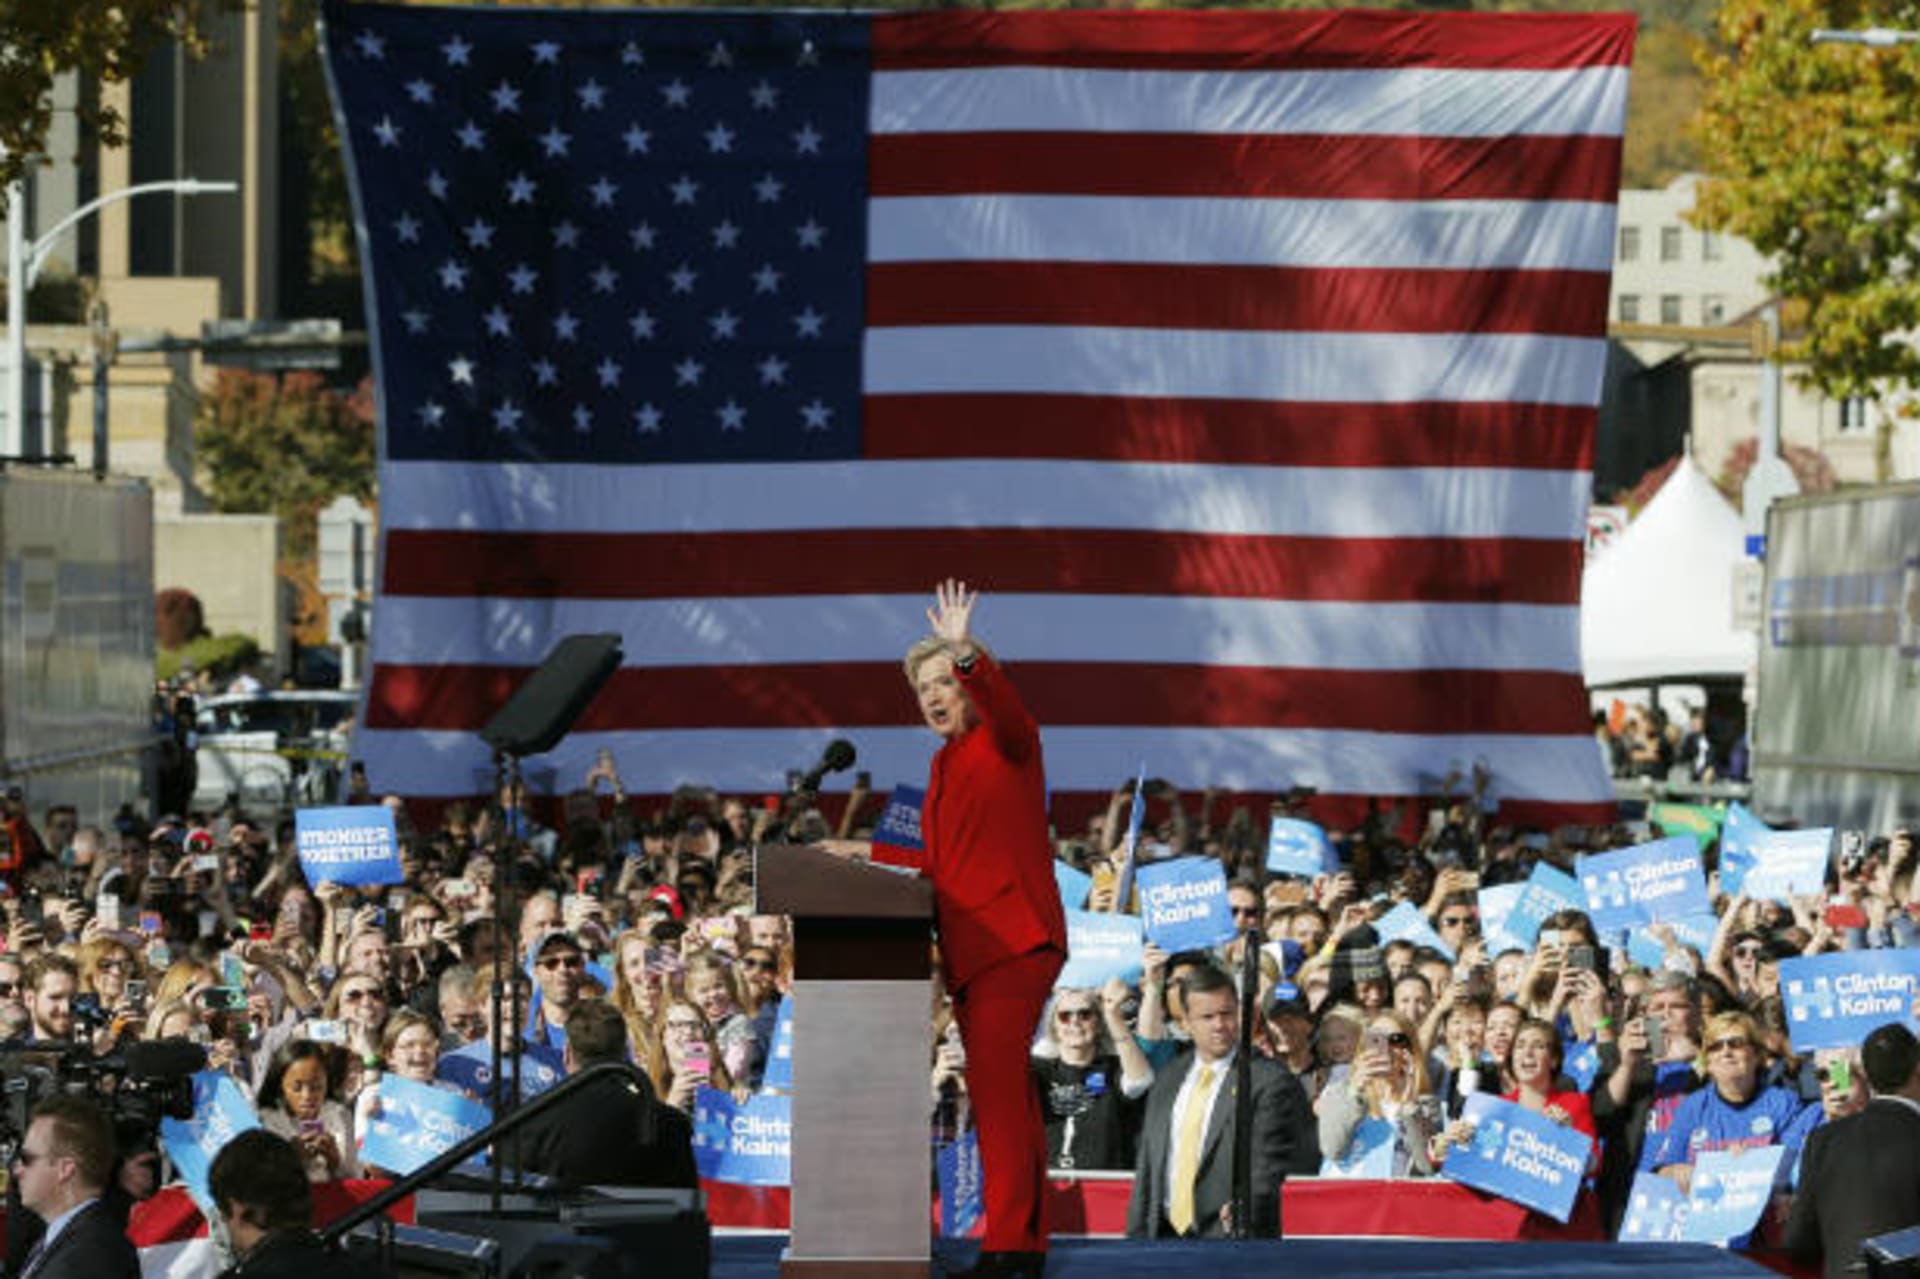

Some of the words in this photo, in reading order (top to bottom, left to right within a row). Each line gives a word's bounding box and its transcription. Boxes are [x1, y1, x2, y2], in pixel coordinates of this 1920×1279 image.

[1624, 857, 1698, 883] Clinton
[1151, 877, 1221, 905] Clinton
[1152, 901, 1212, 926] Kaine
[1835, 973, 1917, 996] Clinton
[1839, 993, 1903, 1017] Kaine
[1507, 1127, 1584, 1174] Clinton
[1502, 1144, 1563, 1184] Kaine
